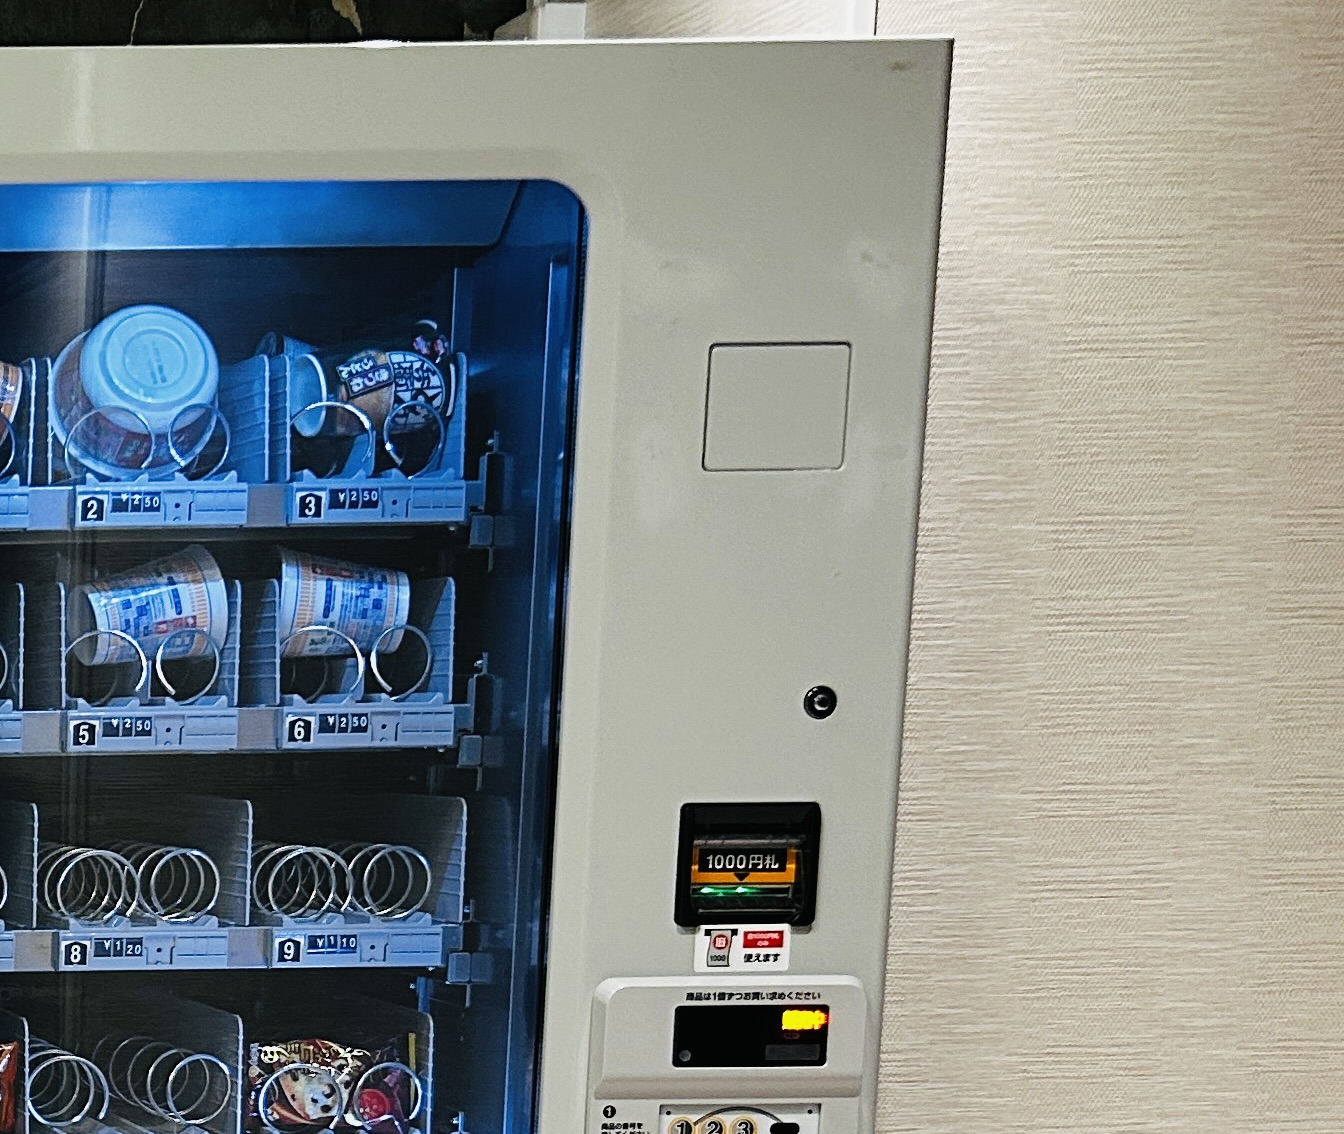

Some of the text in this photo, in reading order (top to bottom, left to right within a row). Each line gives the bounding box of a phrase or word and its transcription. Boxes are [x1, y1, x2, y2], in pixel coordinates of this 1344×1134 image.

[87, 500, 97, 518] 2
[306, 497, 315, 515] 3
[78, 726, 89, 743] 5
[294, 721, 304, 739] 6
[706, 855, 779, 869] 1000円札
[72, 946, 80, 963] 8
[285, 941, 293, 959] 9
[743, 953, 780, 962] 使えます
[686, 992, 821, 1001] 商品は1個ずつお買い求めください
